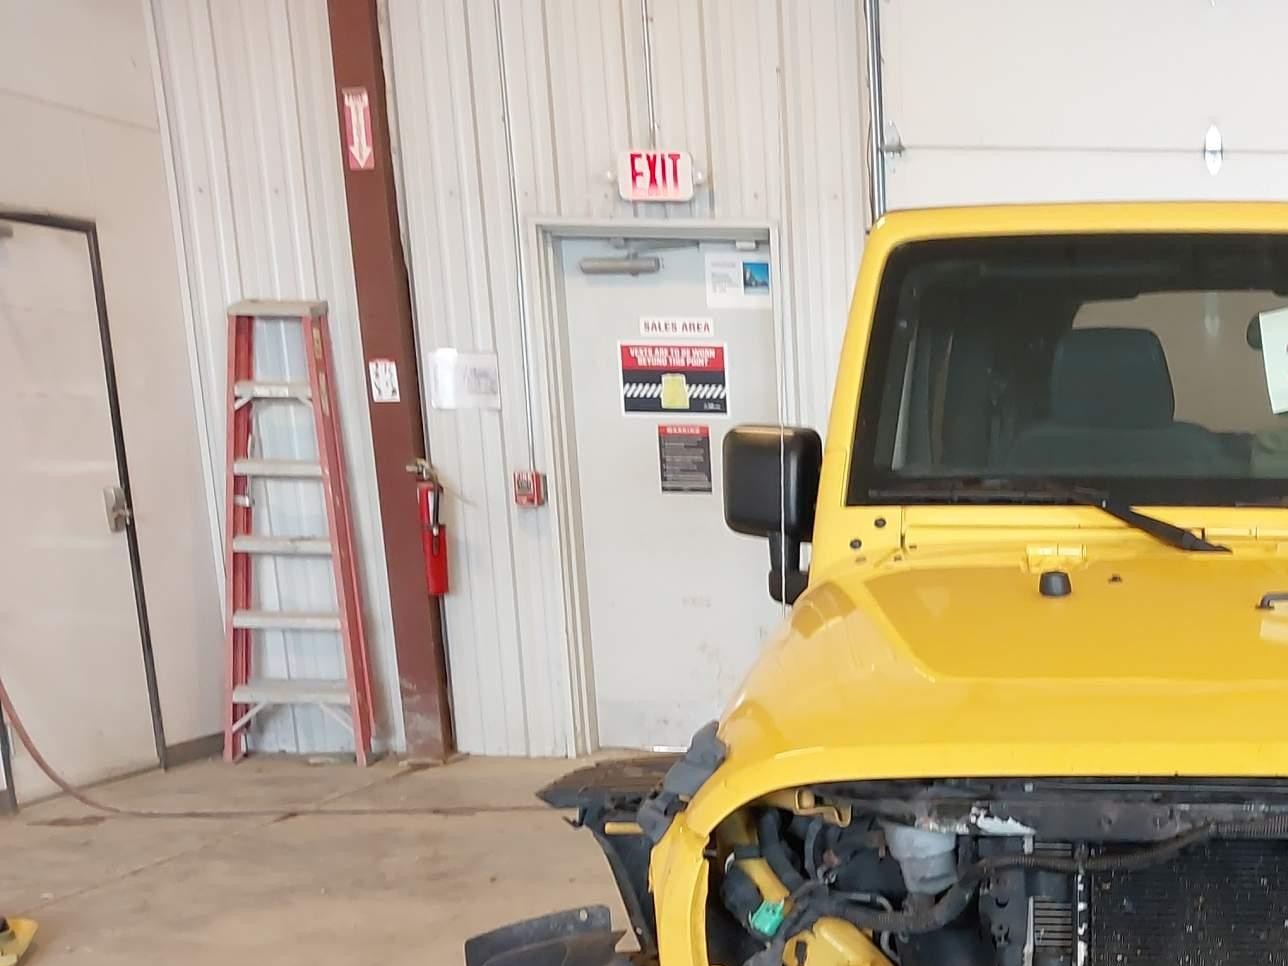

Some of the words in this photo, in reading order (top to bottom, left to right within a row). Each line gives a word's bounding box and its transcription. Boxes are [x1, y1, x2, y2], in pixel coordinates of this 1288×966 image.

[629, 153, 681, 197] EXIT
[643, 320, 677, 333] SALES
[682, 320, 710, 333] AREA
